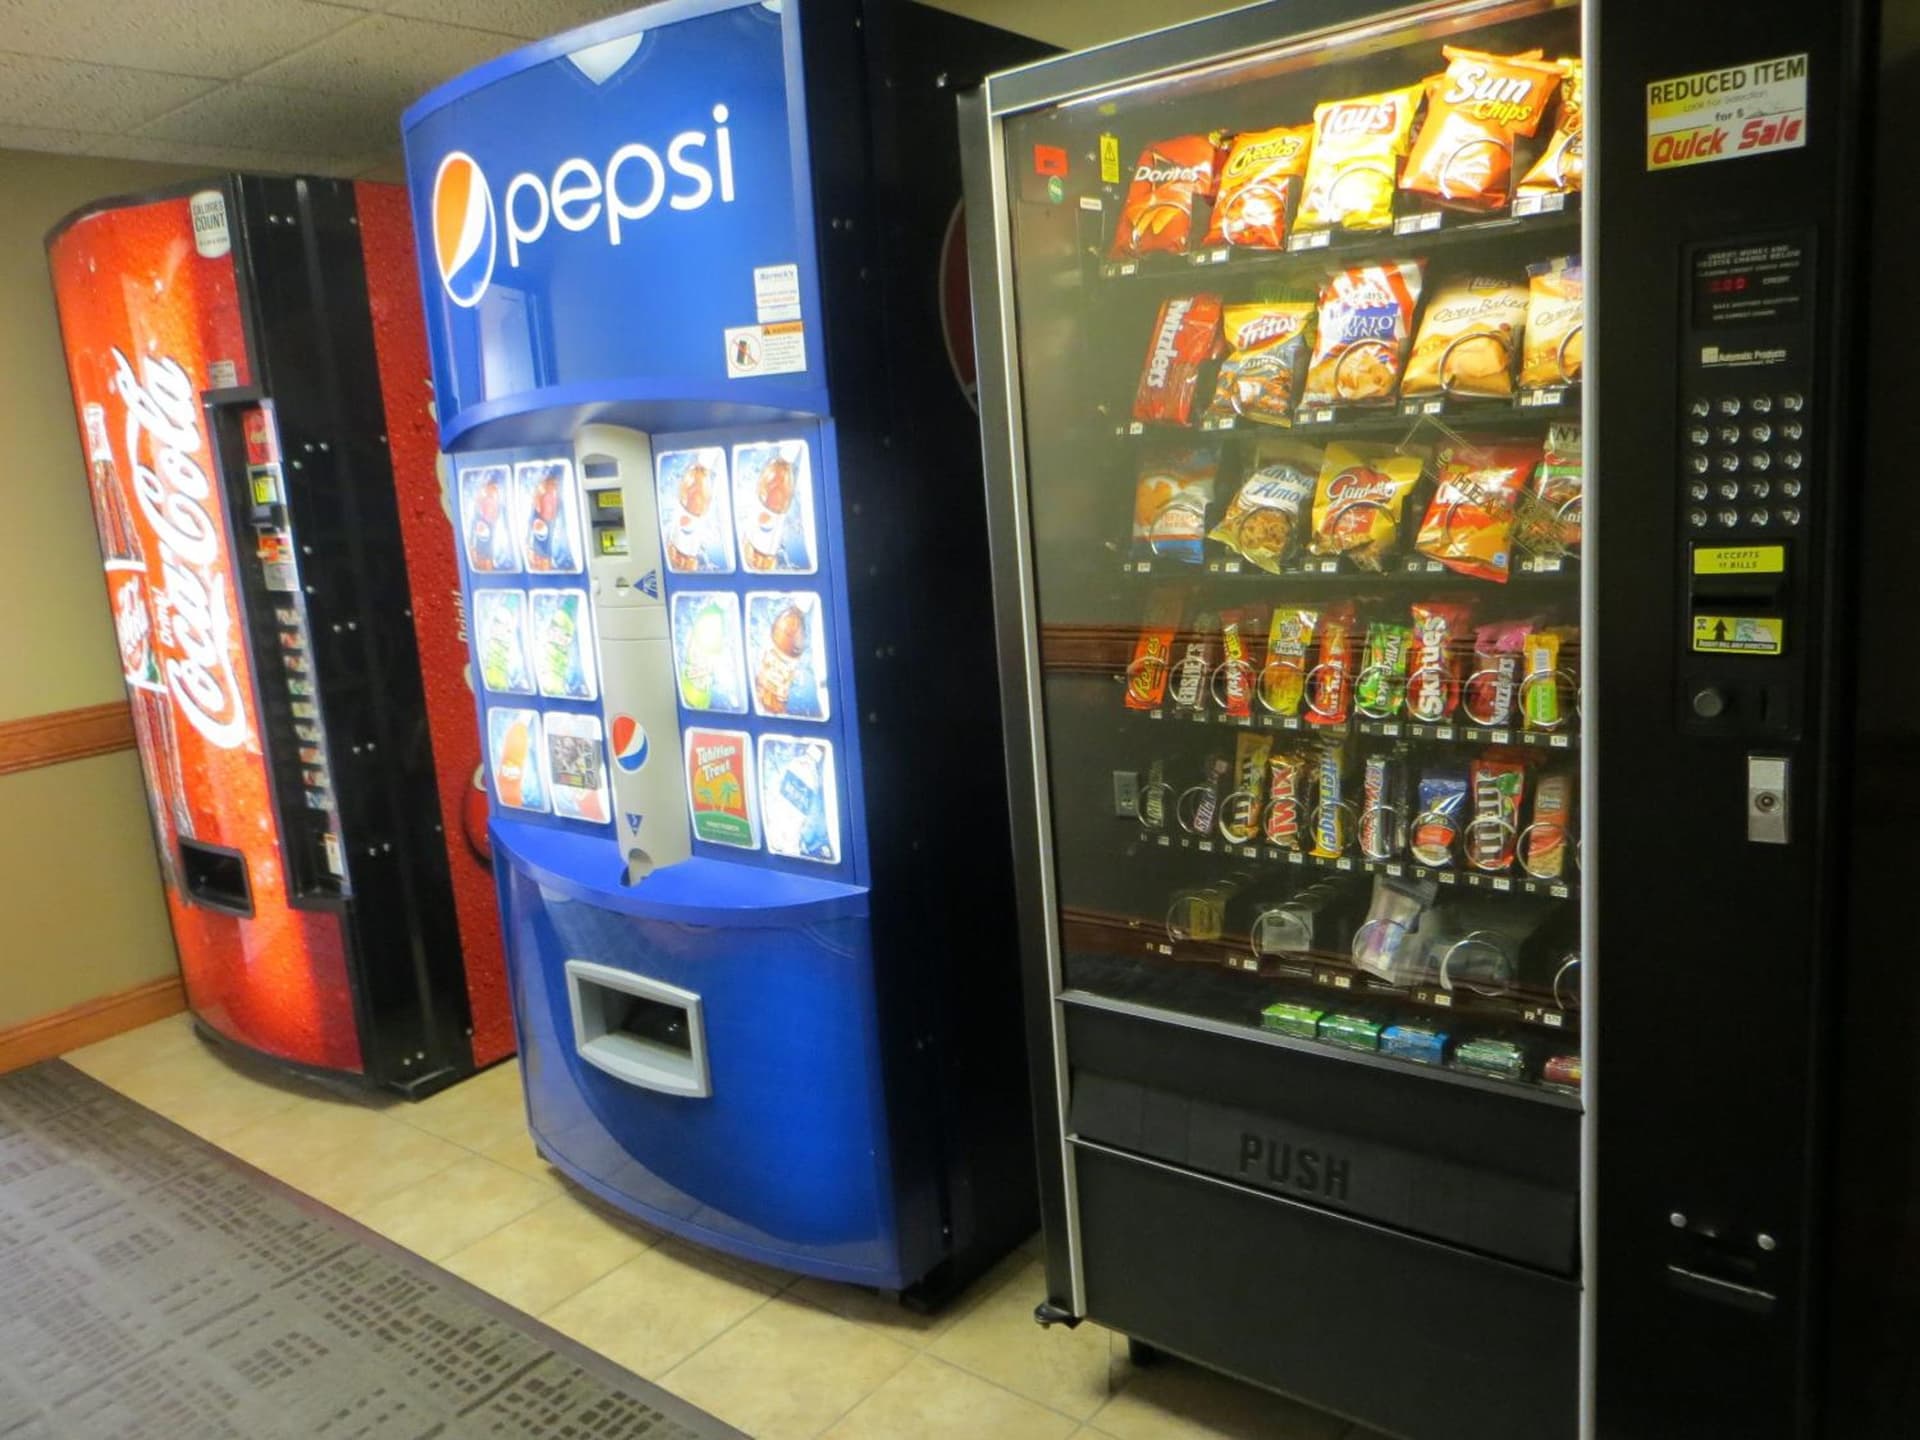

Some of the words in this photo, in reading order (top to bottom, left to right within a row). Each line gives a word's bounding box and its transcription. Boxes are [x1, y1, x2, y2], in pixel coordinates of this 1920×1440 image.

[1445, 68, 1532, 104] Sun
[1651, 69, 1747, 105] REDUCED
[1753, 56, 1805, 86] ITEM
[1474, 101, 1532, 124] Chips
[1715, 110, 1732, 121] for
[1736, 108, 1744, 118] $
[1227, 136, 1304, 177] Cheetos
[1652, 127, 1728, 165] Quick
[1737, 115, 1803, 150] Sale
[505, 104, 735, 268] pepsi
[1134, 164, 1201, 183] Doritos
[194, 213, 226, 232] COUNT
[1237, 315, 1299, 349] Fritos
[112, 345, 248, 752] Coca-Cola
[1716, 551, 1760, 560] ACCEPTS
[1418, 615, 1448, 717] Skittles
[1267, 762, 1298, 839] TWIX
[1240, 1133, 1350, 1200] PUSH
